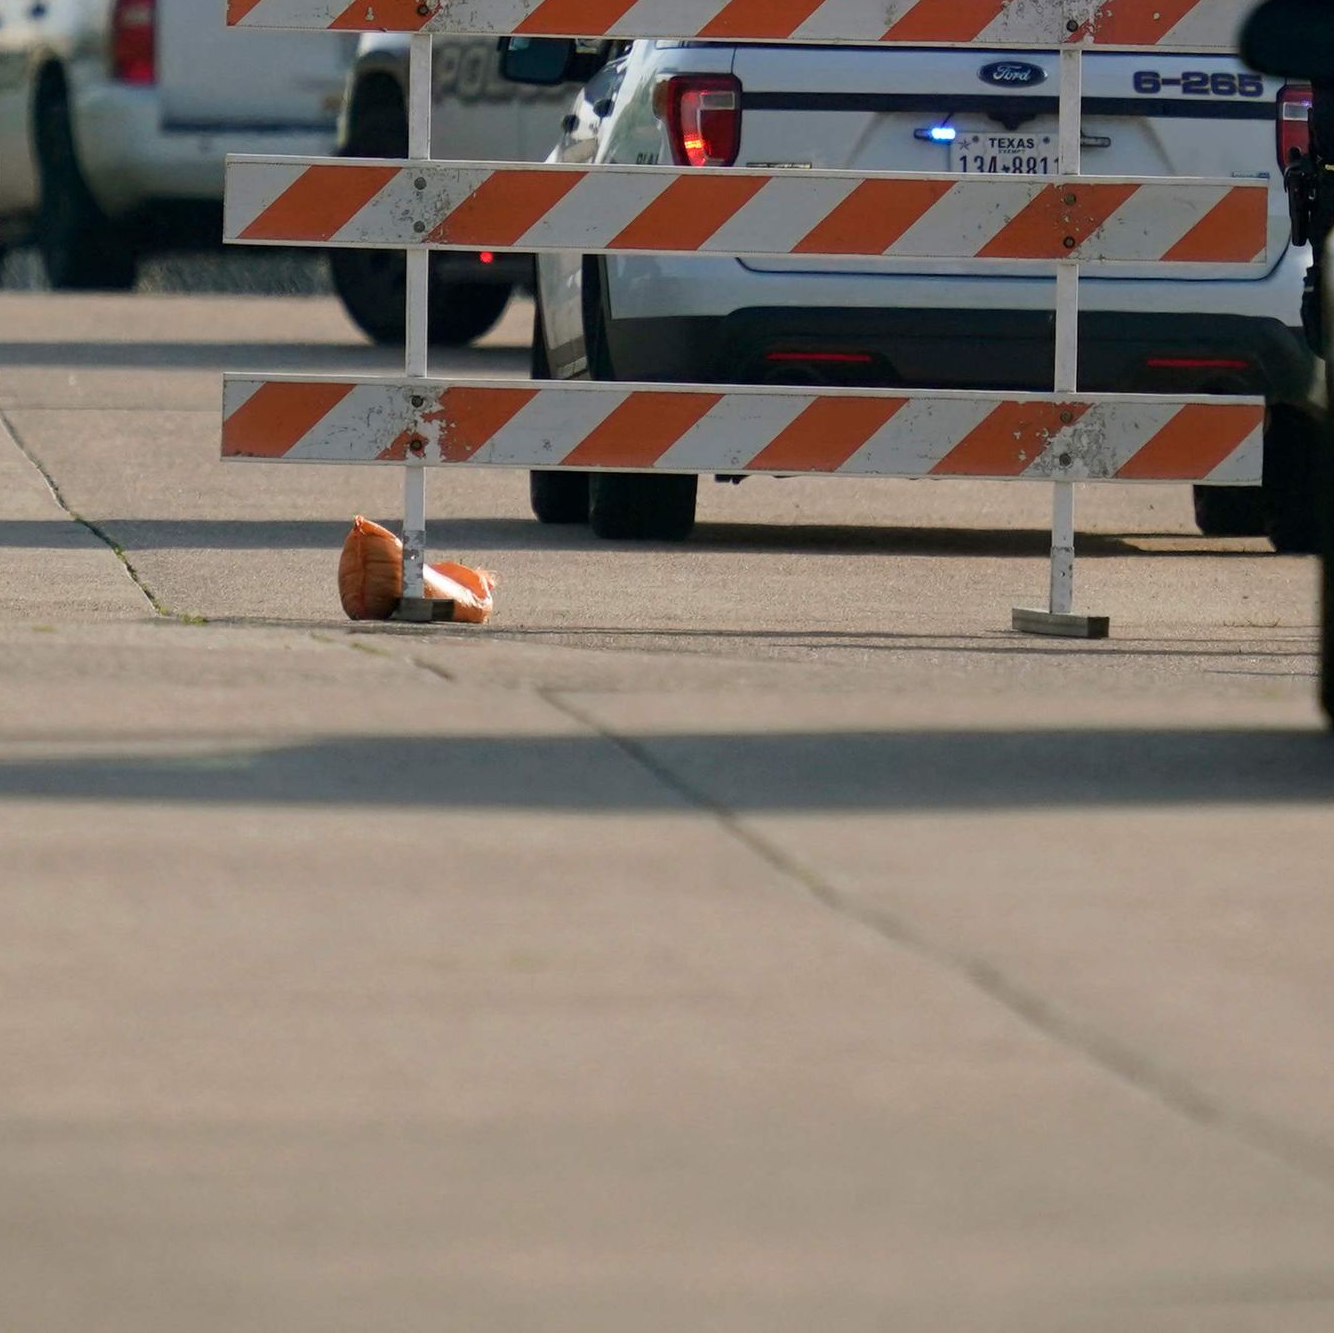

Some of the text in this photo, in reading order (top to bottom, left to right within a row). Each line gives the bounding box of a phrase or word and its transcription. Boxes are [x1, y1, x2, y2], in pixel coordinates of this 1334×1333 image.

[993, 64, 1031, 82] Ford
[1133, 71, 1264, 97] 6-265
[988, 137, 1035, 149] TEXAS
